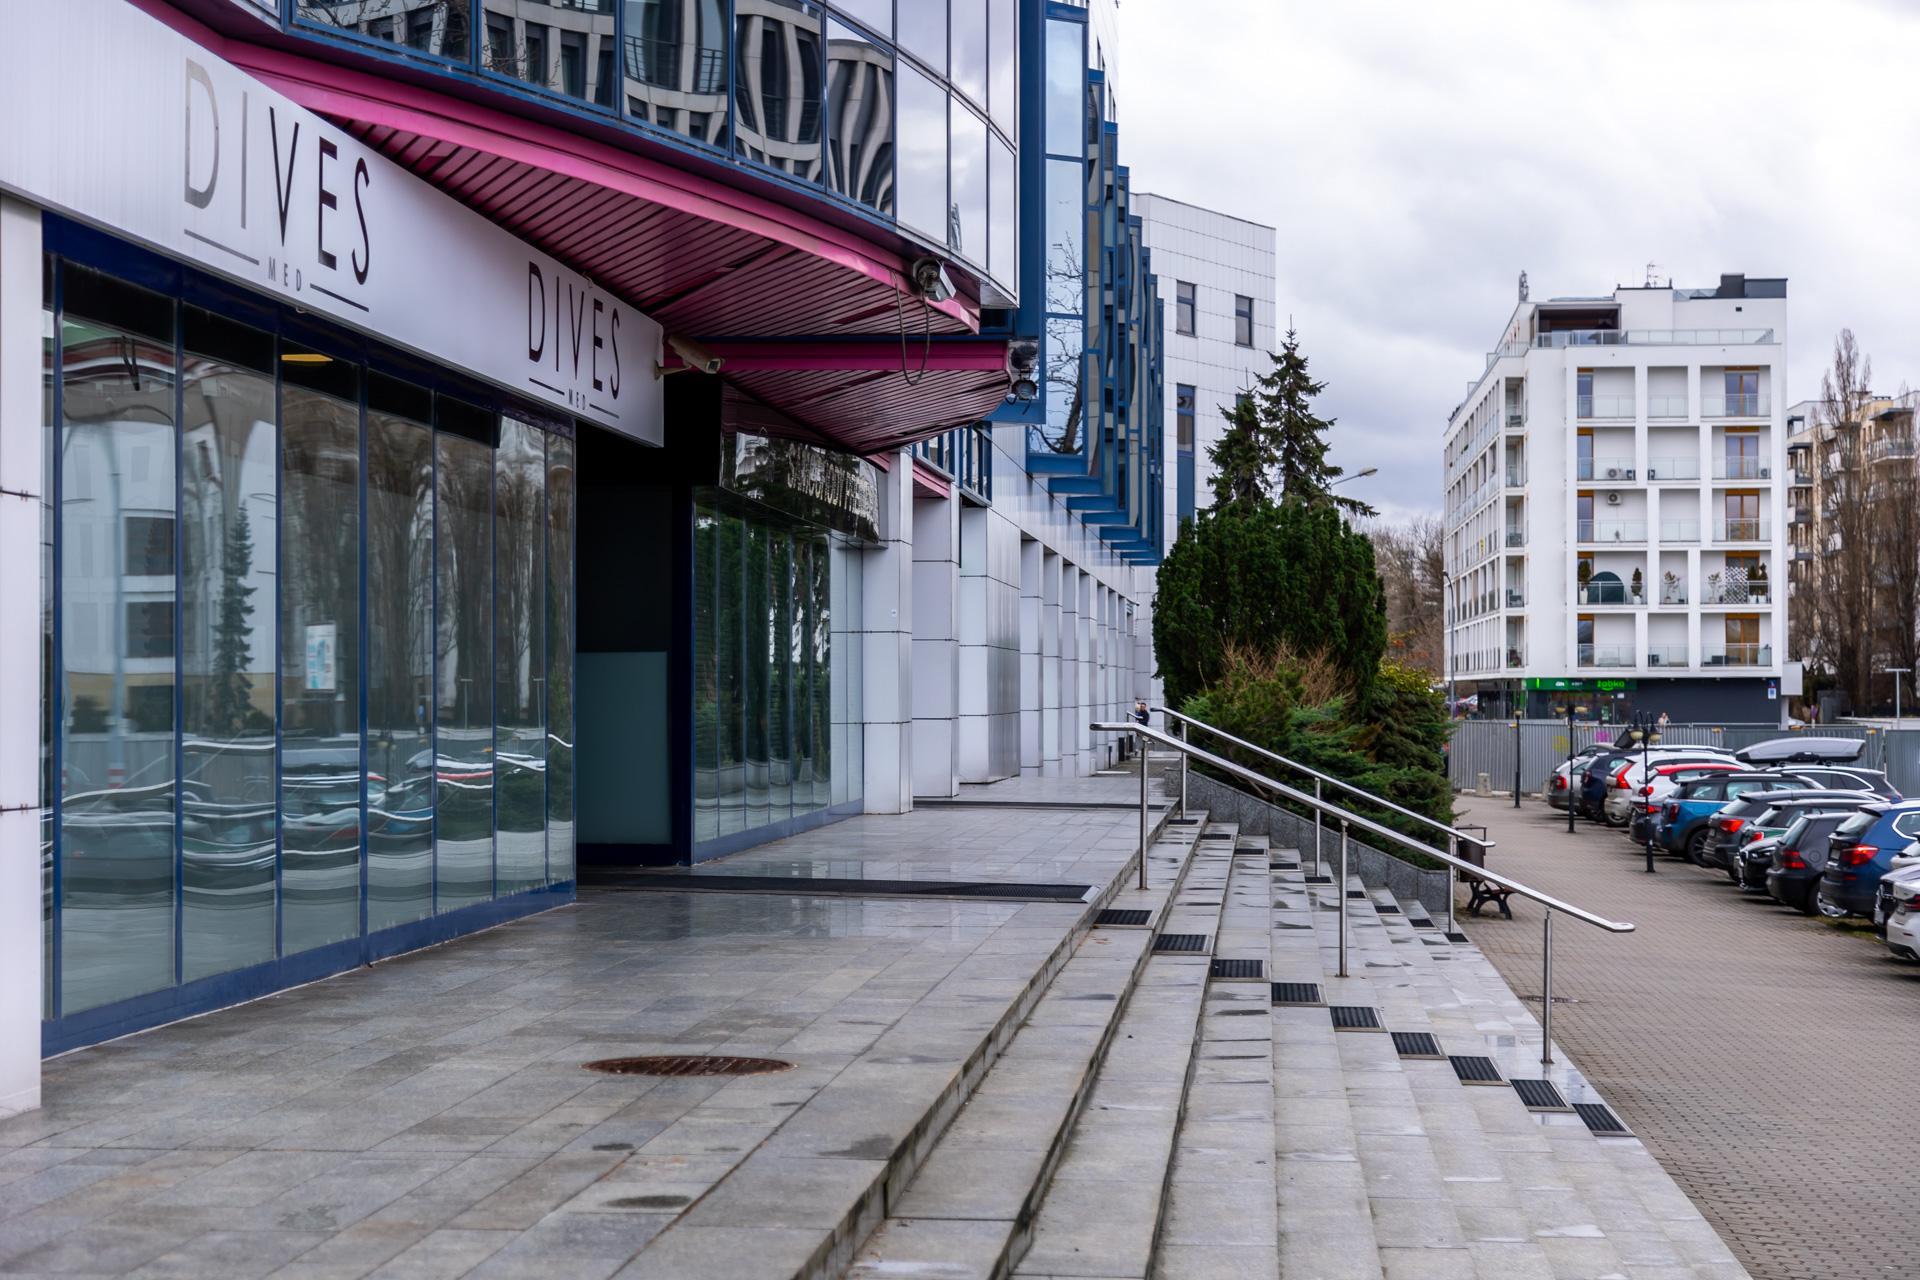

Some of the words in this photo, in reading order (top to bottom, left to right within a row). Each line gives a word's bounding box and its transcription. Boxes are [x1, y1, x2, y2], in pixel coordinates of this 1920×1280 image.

[184, 57, 369, 285] DIVES
[268, 256, 301, 291] MED
[529, 261, 620, 400] DIVES
[569, 388, 585, 410] MED
